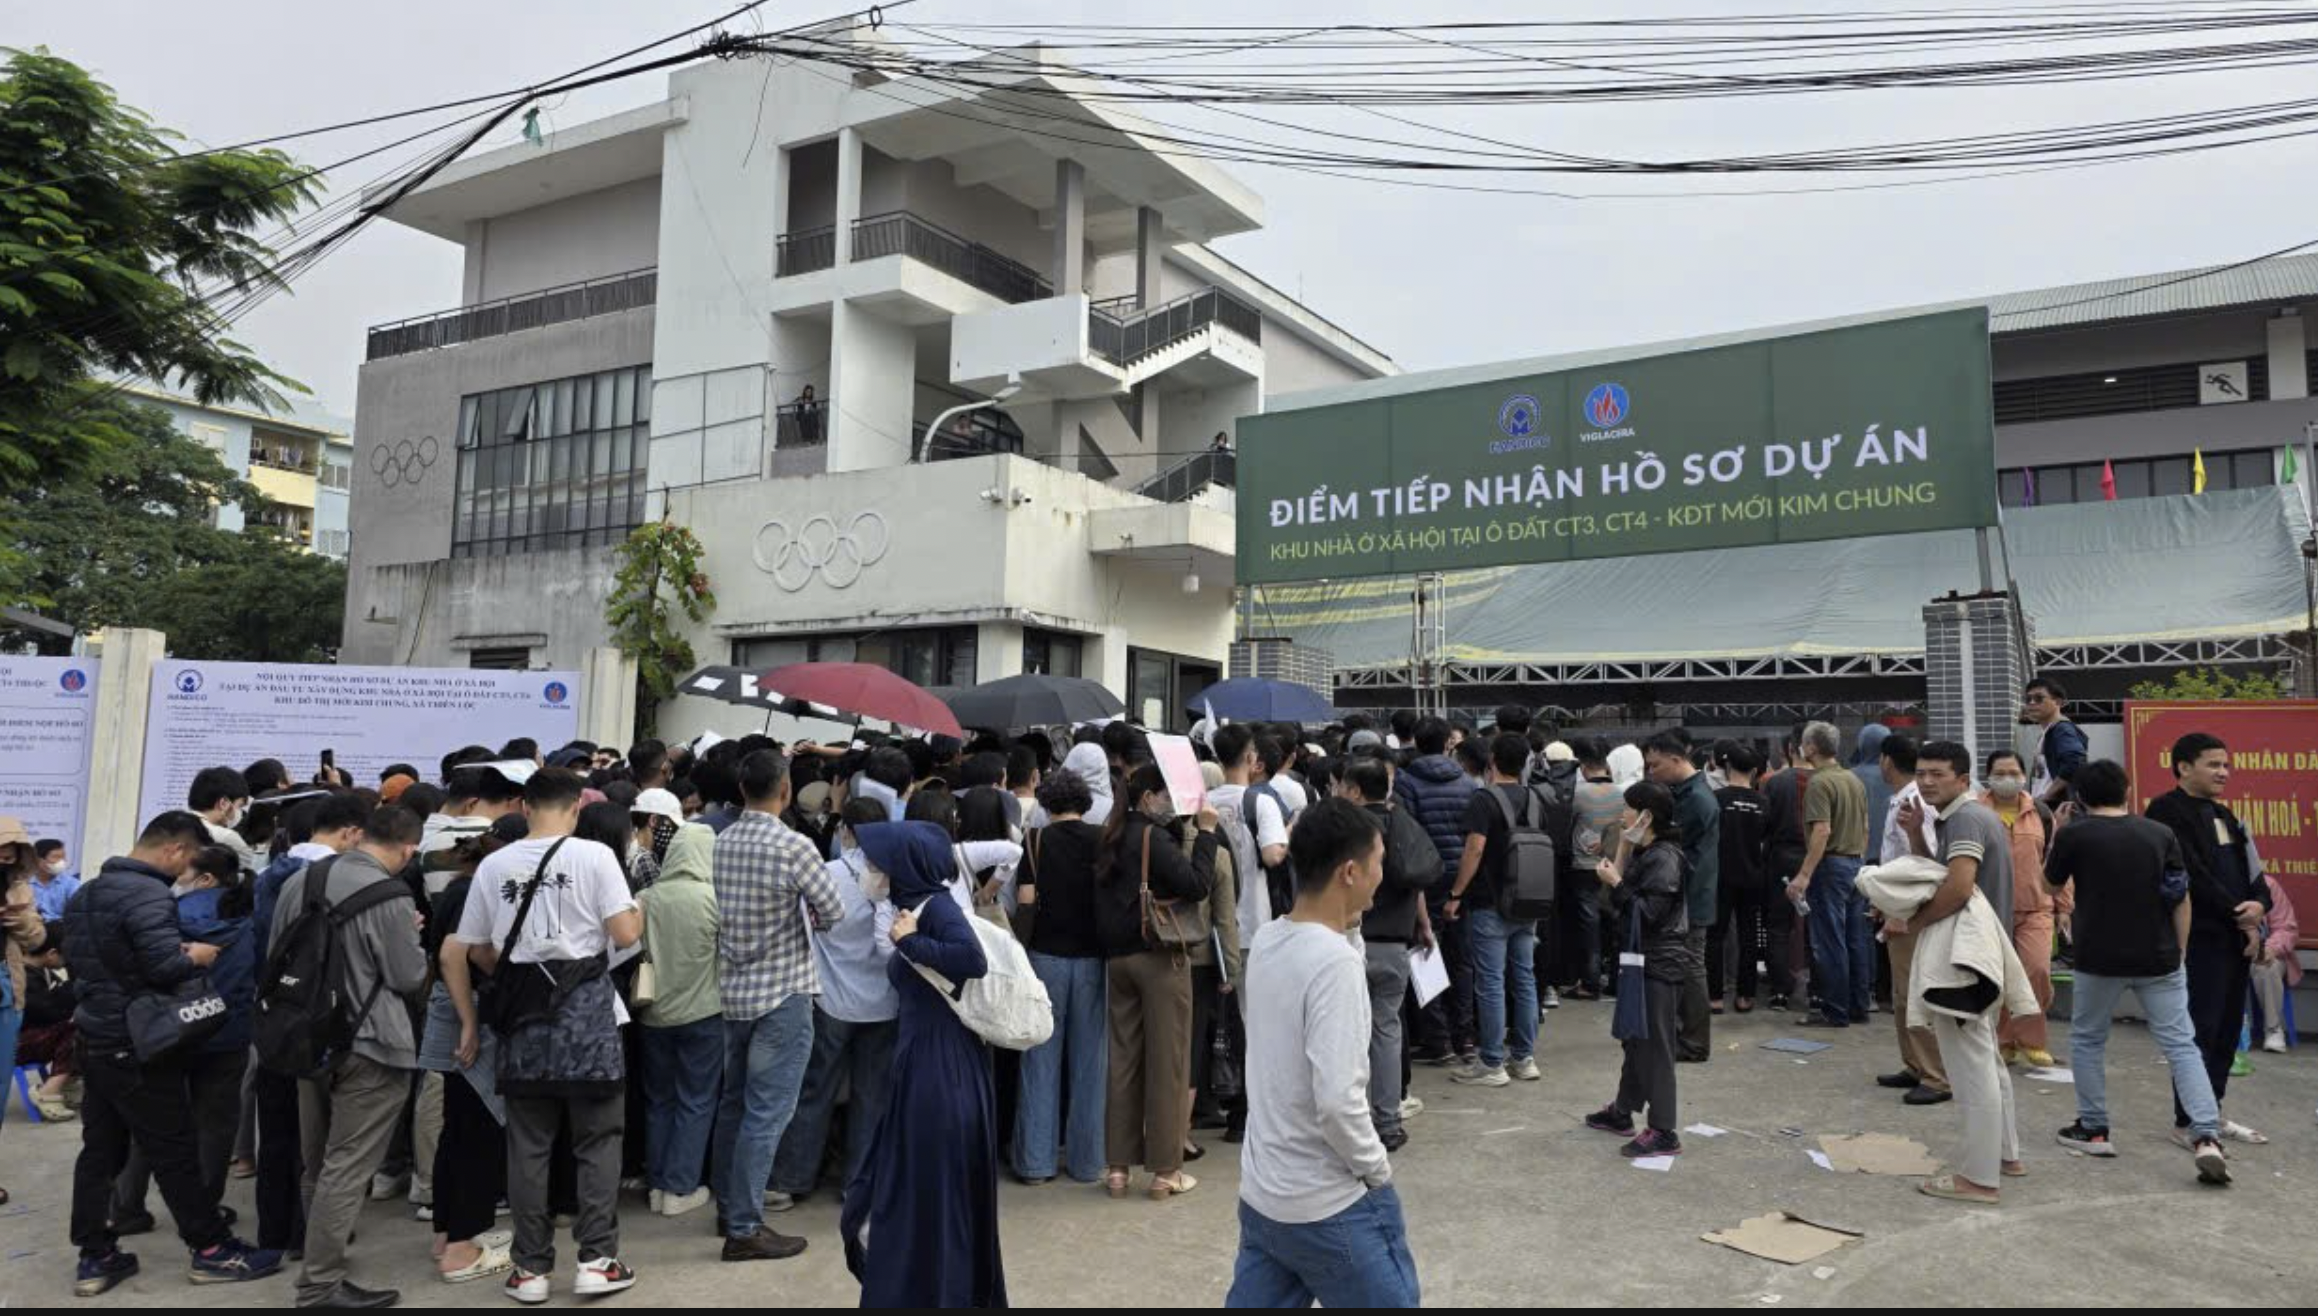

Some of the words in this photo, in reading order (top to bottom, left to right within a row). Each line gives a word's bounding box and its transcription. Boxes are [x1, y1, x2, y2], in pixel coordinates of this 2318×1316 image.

[1269, 485, 1359, 528] ĐIỂM
[1371, 474, 1452, 518] TIẾP
[1464, 464, 1584, 509] NHẬN
[1601, 450, 1667, 495] HỒ
[1682, 444, 1746, 486] SƠ
[1763, 433, 1843, 480] DỰ
[1854, 423, 1928, 468] ÁN
[1270, 541, 1309, 561] KHU
[1313, 533, 1355, 558] NHÀ
[1357, 531, 1376, 552] Ở
[1379, 529, 1405, 552] XÃ
[1409, 526, 1446, 552] HỘI
[1450, 526, 1480, 549] TẠI
[1485, 519, 1503, 543] Ô
[1508, 514, 1549, 541] ĐẤT
[1554, 516, 1600, 537] CT3,
[1605, 510, 1648, 532] CT4
[1668, 503, 1716, 527] KĐT
[1721, 494, 1773, 523] MỚI
[1780, 492, 1828, 517] KIM
[1834, 481, 1936, 511] CHUNG
[178, 997, 226, 1023] adidas
